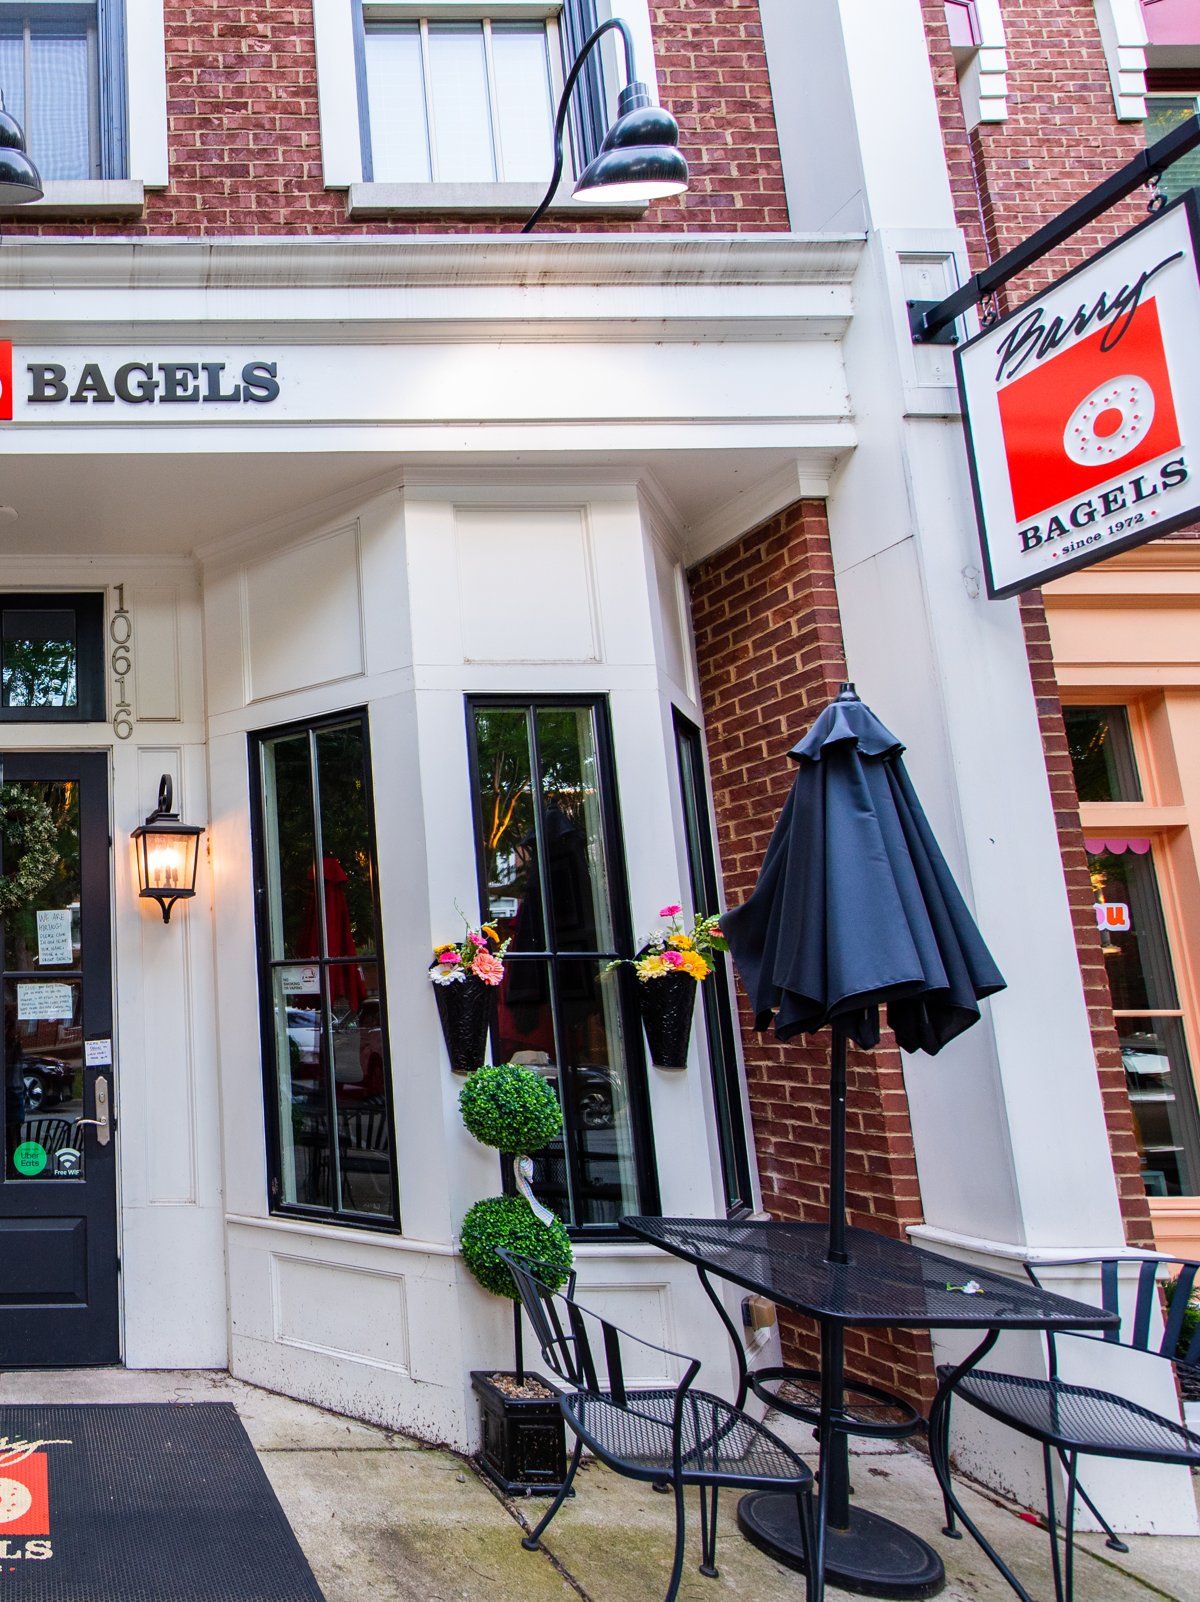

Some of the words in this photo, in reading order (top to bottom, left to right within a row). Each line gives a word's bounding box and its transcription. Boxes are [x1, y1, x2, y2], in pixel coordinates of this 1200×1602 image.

[996, 251, 1184, 382] Barry
[26, 361, 281, 403] BAGELS
[1018, 456, 1189, 553] BAGELS
[1061, 530, 1101, 556] since
[1107, 512, 1145, 538] 1972
[110, 583, 133, 740] 10616
